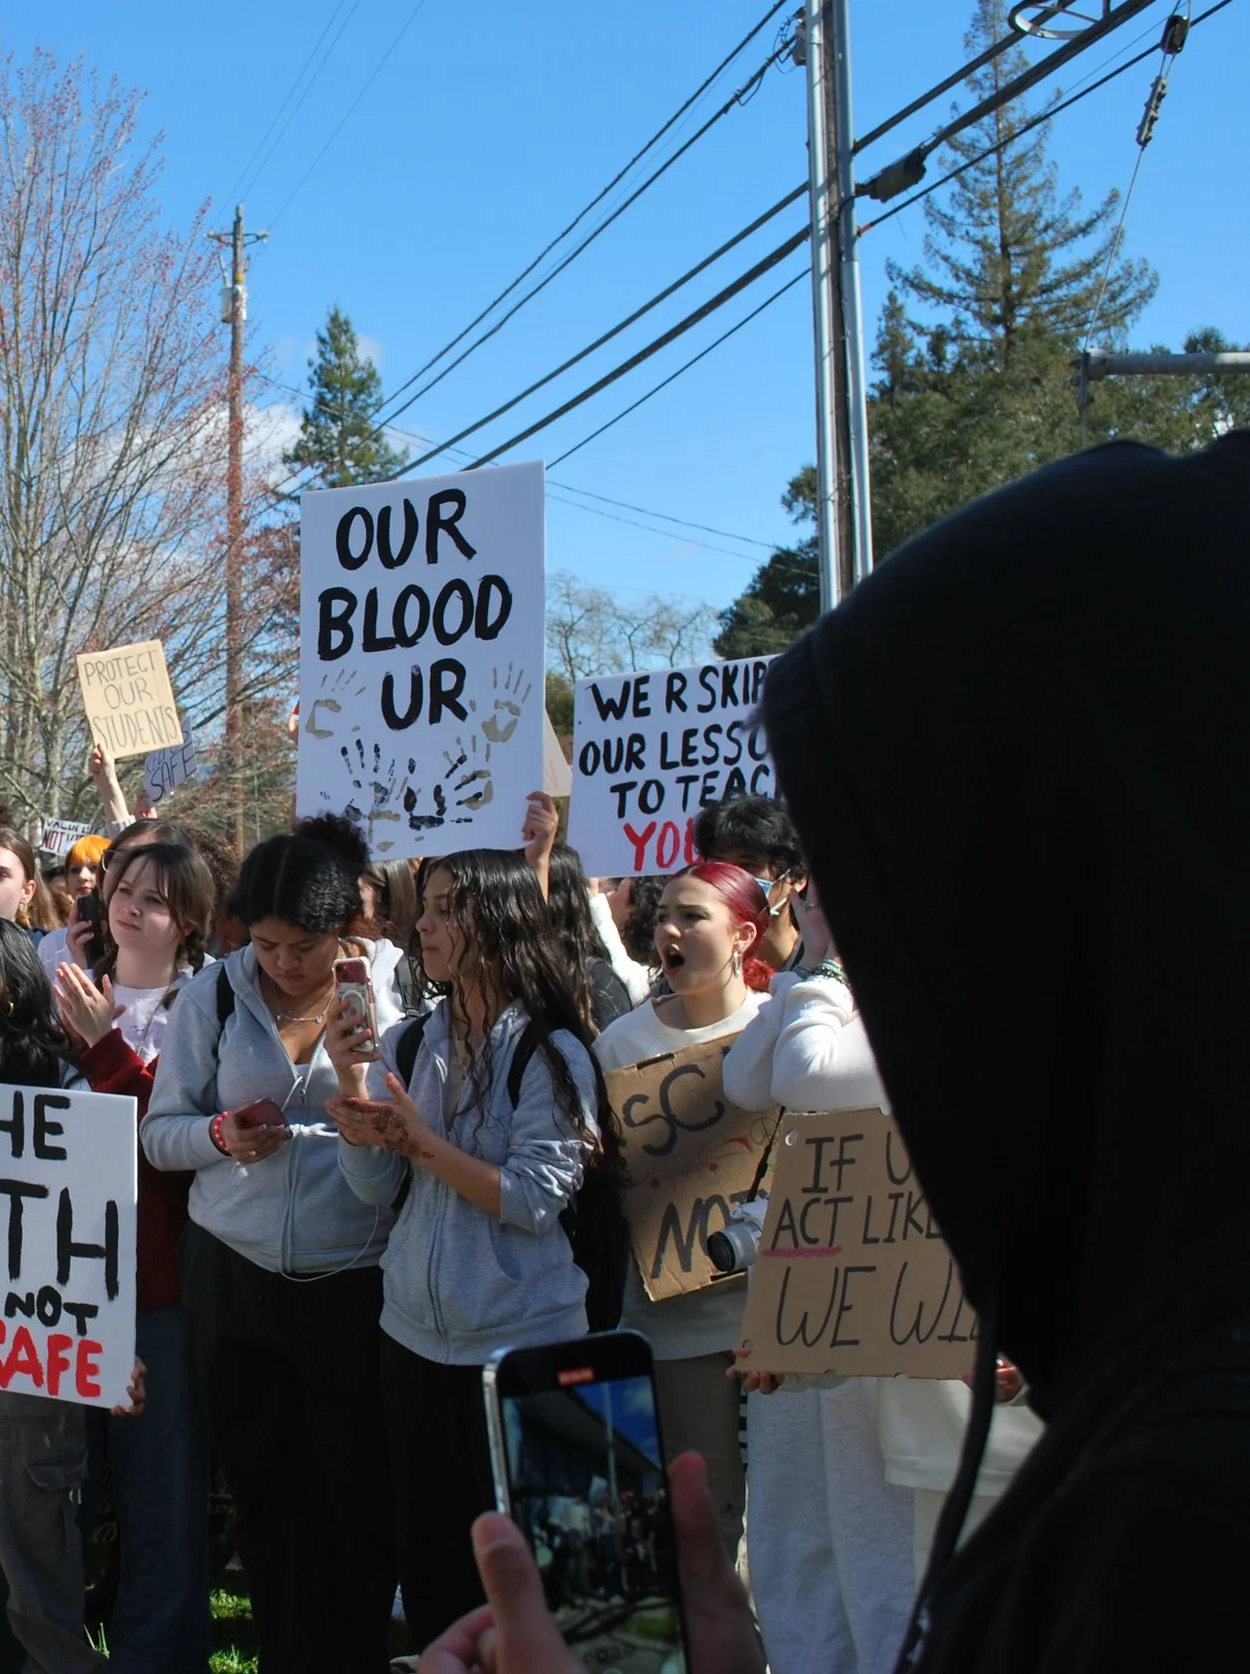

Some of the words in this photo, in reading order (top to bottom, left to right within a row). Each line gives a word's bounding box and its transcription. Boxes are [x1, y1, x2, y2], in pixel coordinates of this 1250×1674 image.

[336, 488, 477, 571] OUR
[318, 575, 512, 660] BLOOD
[84, 649, 158, 686] PROTECT
[104, 678, 153, 710] OUR
[381, 657, 468, 731] UR
[585, 675, 650, 722] WE
[665, 672, 687, 713] R
[697, 661, 768, 713] SKIP
[92, 706, 179, 754] STUDENTS
[579, 733, 646, 776] OUR
[660, 721, 769, 770] LESSO
[150, 743, 197, 802] SAFE
[610, 779, 666, 819] TO
[675, 764, 775, 812] TEAC
[44, 829, 66, 853] NOT
[622, 1064, 725, 1157] SC
[802, 1134, 864, 1194] IF
[771, 1196, 853, 1251] ACT
[4, 1286, 98, 1336] NOT
[775, 1265, 877, 1348] WE
